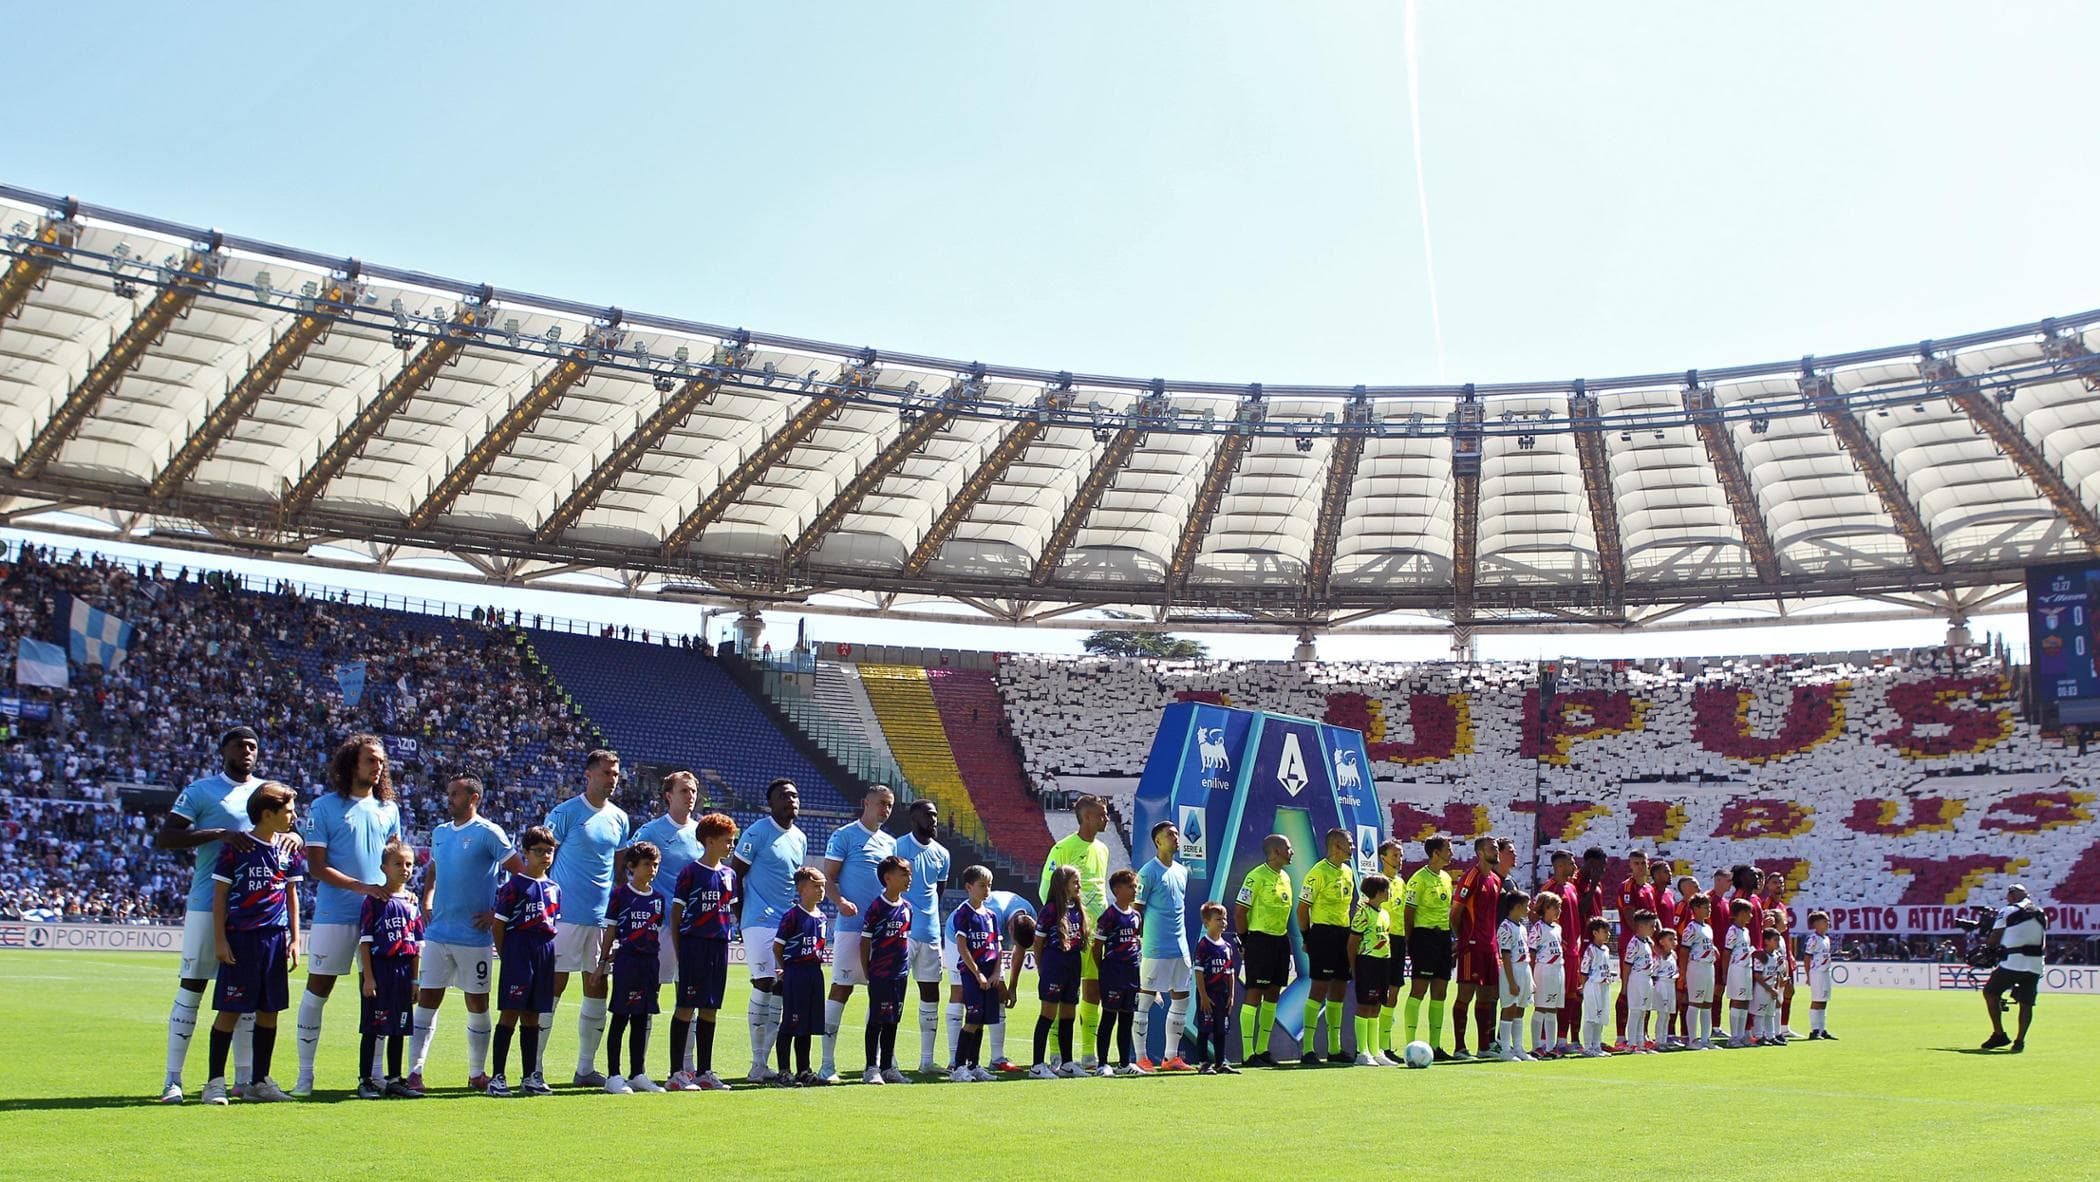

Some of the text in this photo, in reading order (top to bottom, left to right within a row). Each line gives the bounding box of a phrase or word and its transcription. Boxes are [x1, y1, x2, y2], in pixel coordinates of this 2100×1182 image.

[2074, 606, 2083, 626] 0
[2075, 635, 2085, 656] 0
[1201, 777, 1230, 790] enilive
[1338, 795, 1361, 807] enilive
[1183, 844, 1203, 854] SERIE A
[56, 928, 172, 947] PORTOFINO
[476, 961, 488, 979] 9
[2047, 969, 2099, 989] ORT
[1864, 977, 1916, 985] CLUB
